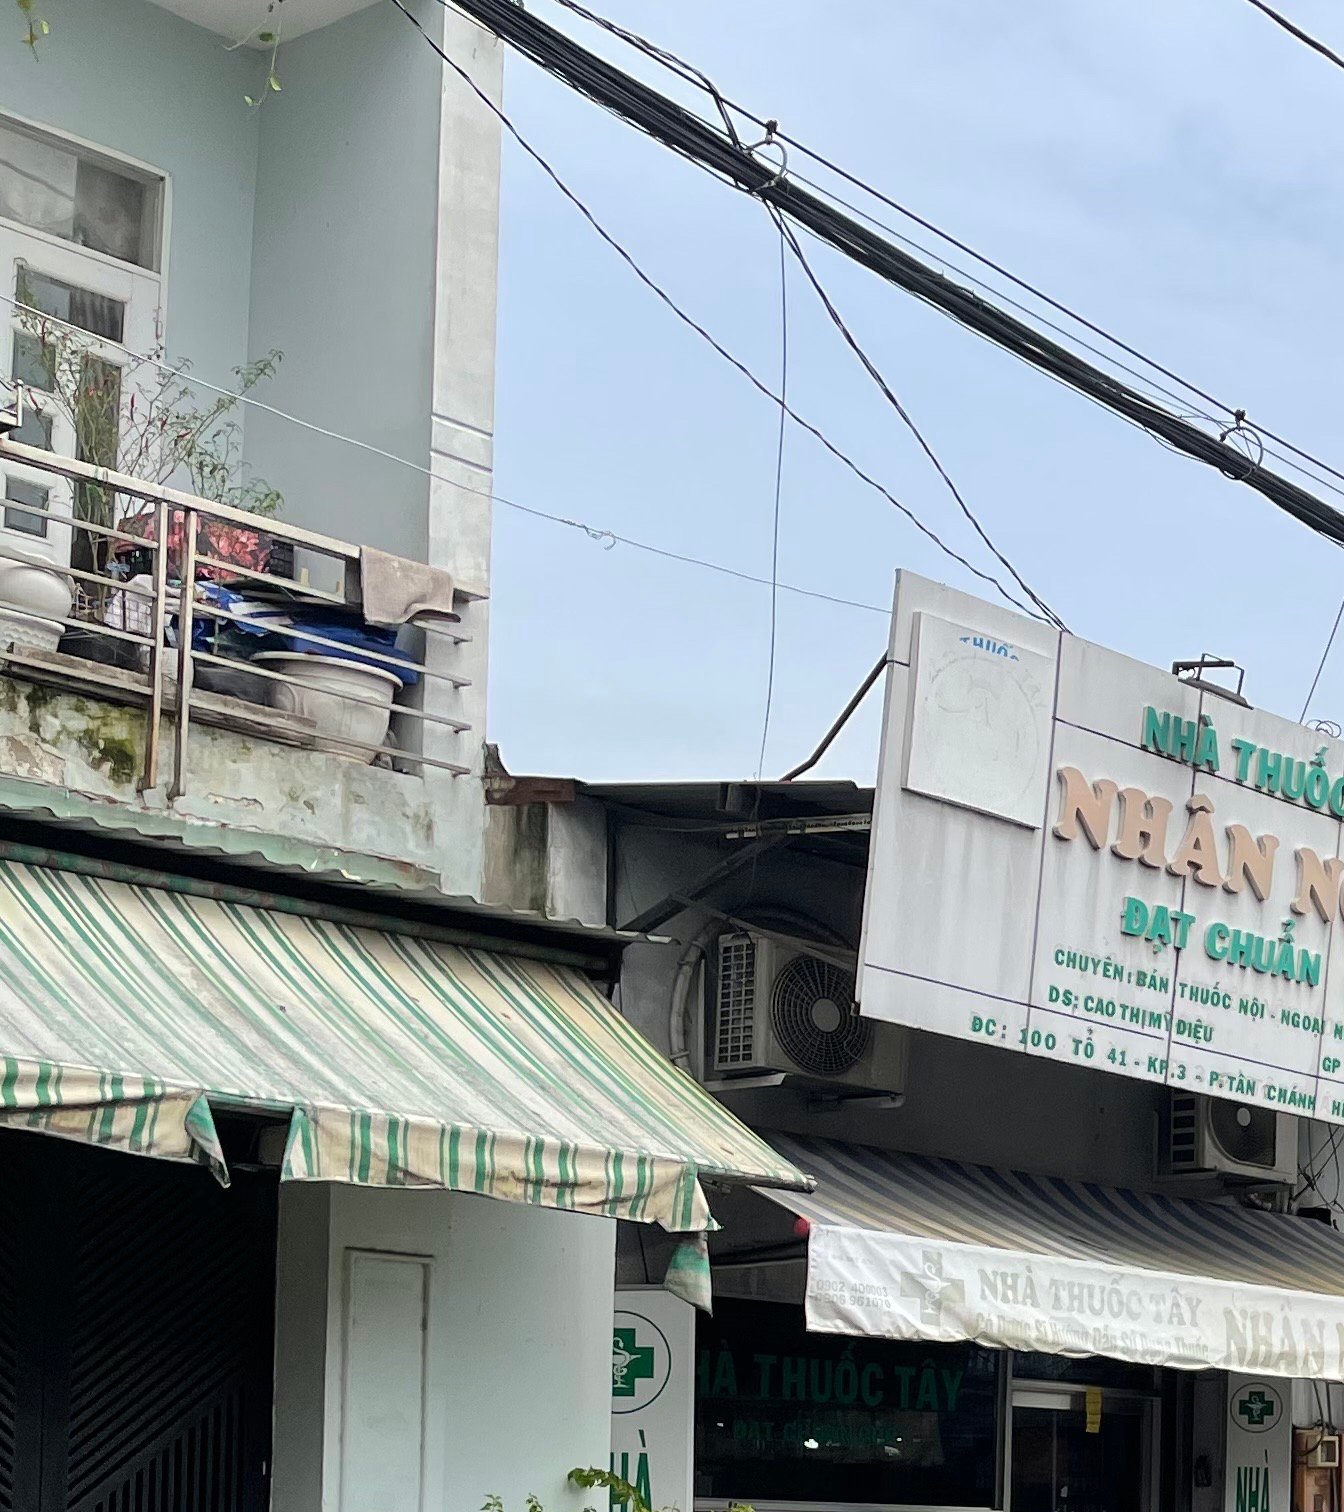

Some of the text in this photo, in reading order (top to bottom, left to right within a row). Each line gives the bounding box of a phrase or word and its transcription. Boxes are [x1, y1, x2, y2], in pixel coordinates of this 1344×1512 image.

[1143, 705, 1218, 772] NHÀ
[1054, 767, 1279, 900] NHÂN
[1121, 897, 1196, 957] ĐẠT
[1205, 918, 1321, 987] CHUẨN
[1084, 995, 1116, 1018] CAO
[1176, 1018, 1213, 1044] DIỆU
[1135, 969, 1169, 994] BÁN
[1179, 982, 1232, 1010] THUỐC
[1238, 998, 1265, 1022] NỘI
[1281, 1009, 1324, 1038] NGOẠI
[1018, 1027, 1056, 1051] 100
[1072, 1028, 1095, 1059] TỔ
[1107, 1047, 1128, 1067] 41
[1267, 1079, 1317, 1111] CHÁNH
[1322, 1056, 1341, 1074] GP
[978, 1265, 1041, 1308] NHÀ
[1049, 1273, 1143, 1320] THUỐC
[1149, 1286, 1203, 1327] TÂY
[1223, 1303, 1327, 1377] NHÂN
[754, 1340, 885, 1407] THUỐC
[895, 1356, 965, 1411] TÂY
